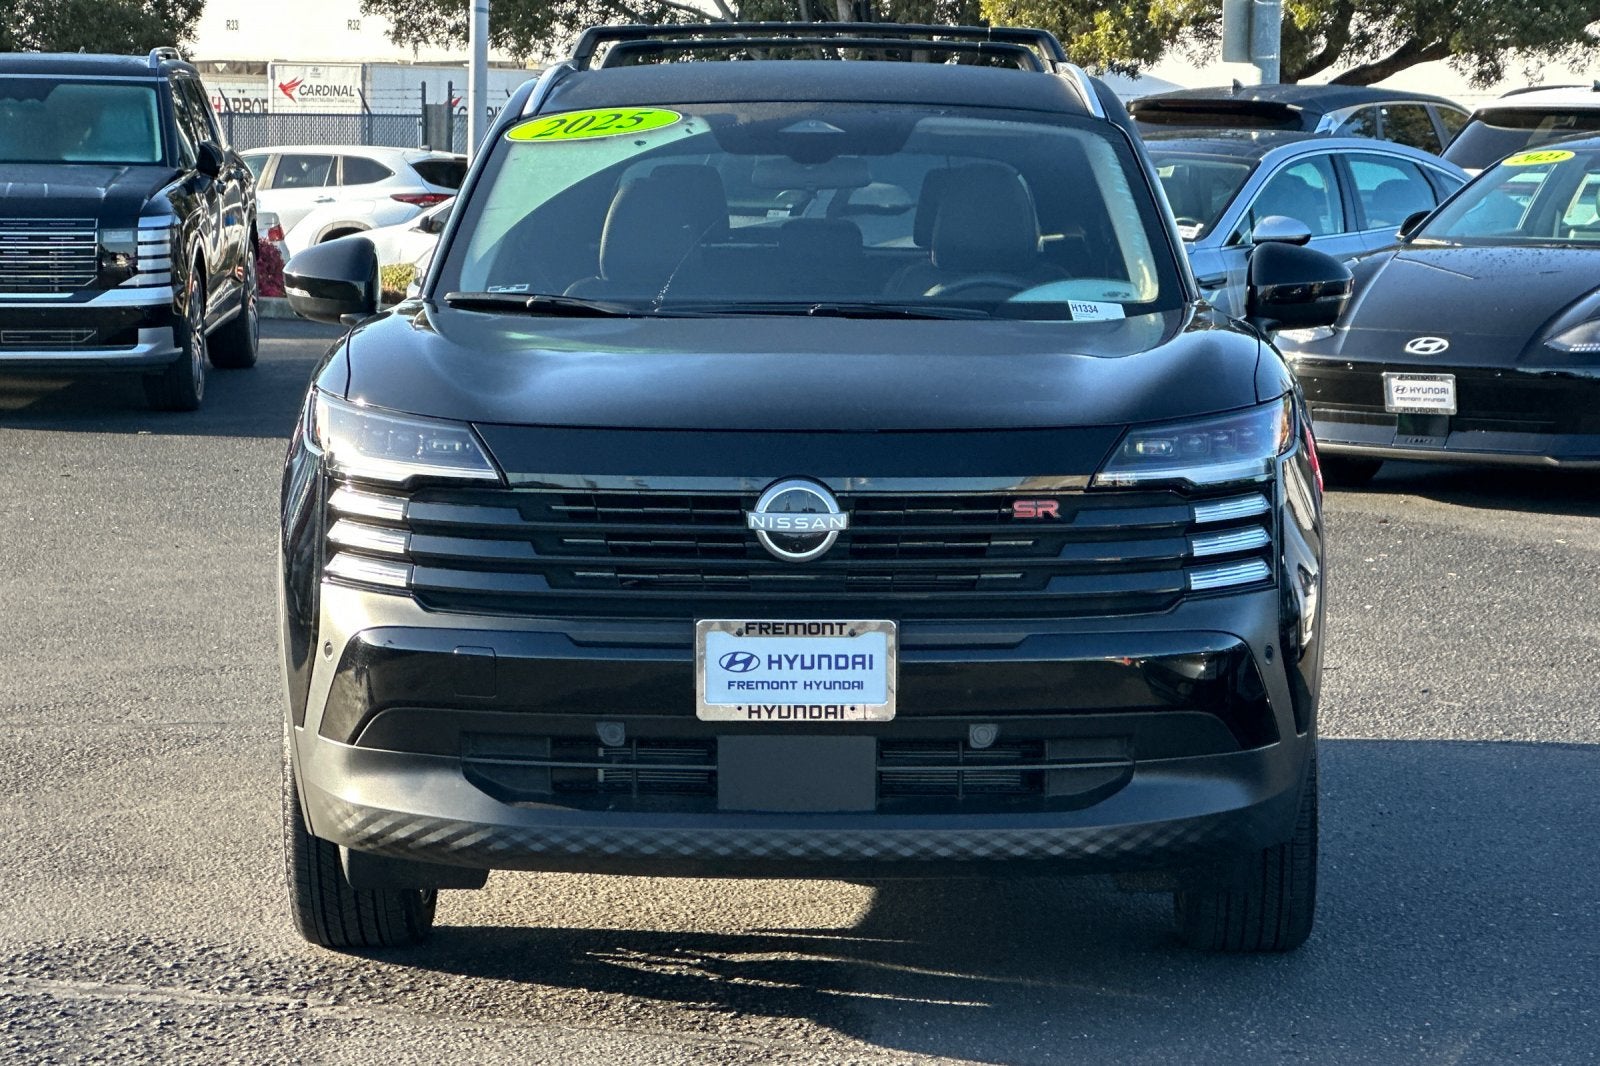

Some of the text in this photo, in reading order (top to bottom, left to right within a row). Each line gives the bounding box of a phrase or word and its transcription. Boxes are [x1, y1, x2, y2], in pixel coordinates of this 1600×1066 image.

[226, 20, 239, 30] R33
[347, 20, 360, 30] R32
[299, 84, 355, 97] CARDINAL
[531, 111, 654, 138] 2025
[1071, 304, 1099, 313] H1334
[1409, 387, 1449, 395] HYUNDAI
[1013, 500, 1060, 519] SR
[751, 515, 845, 529] NISSAN
[745, 622, 848, 636] FREMONT
[767, 654, 874, 670] HYUNDAI
[727, 680, 864, 690] FREMONT HYUNDAI
[748, 705, 845, 719] HYUNDAI
